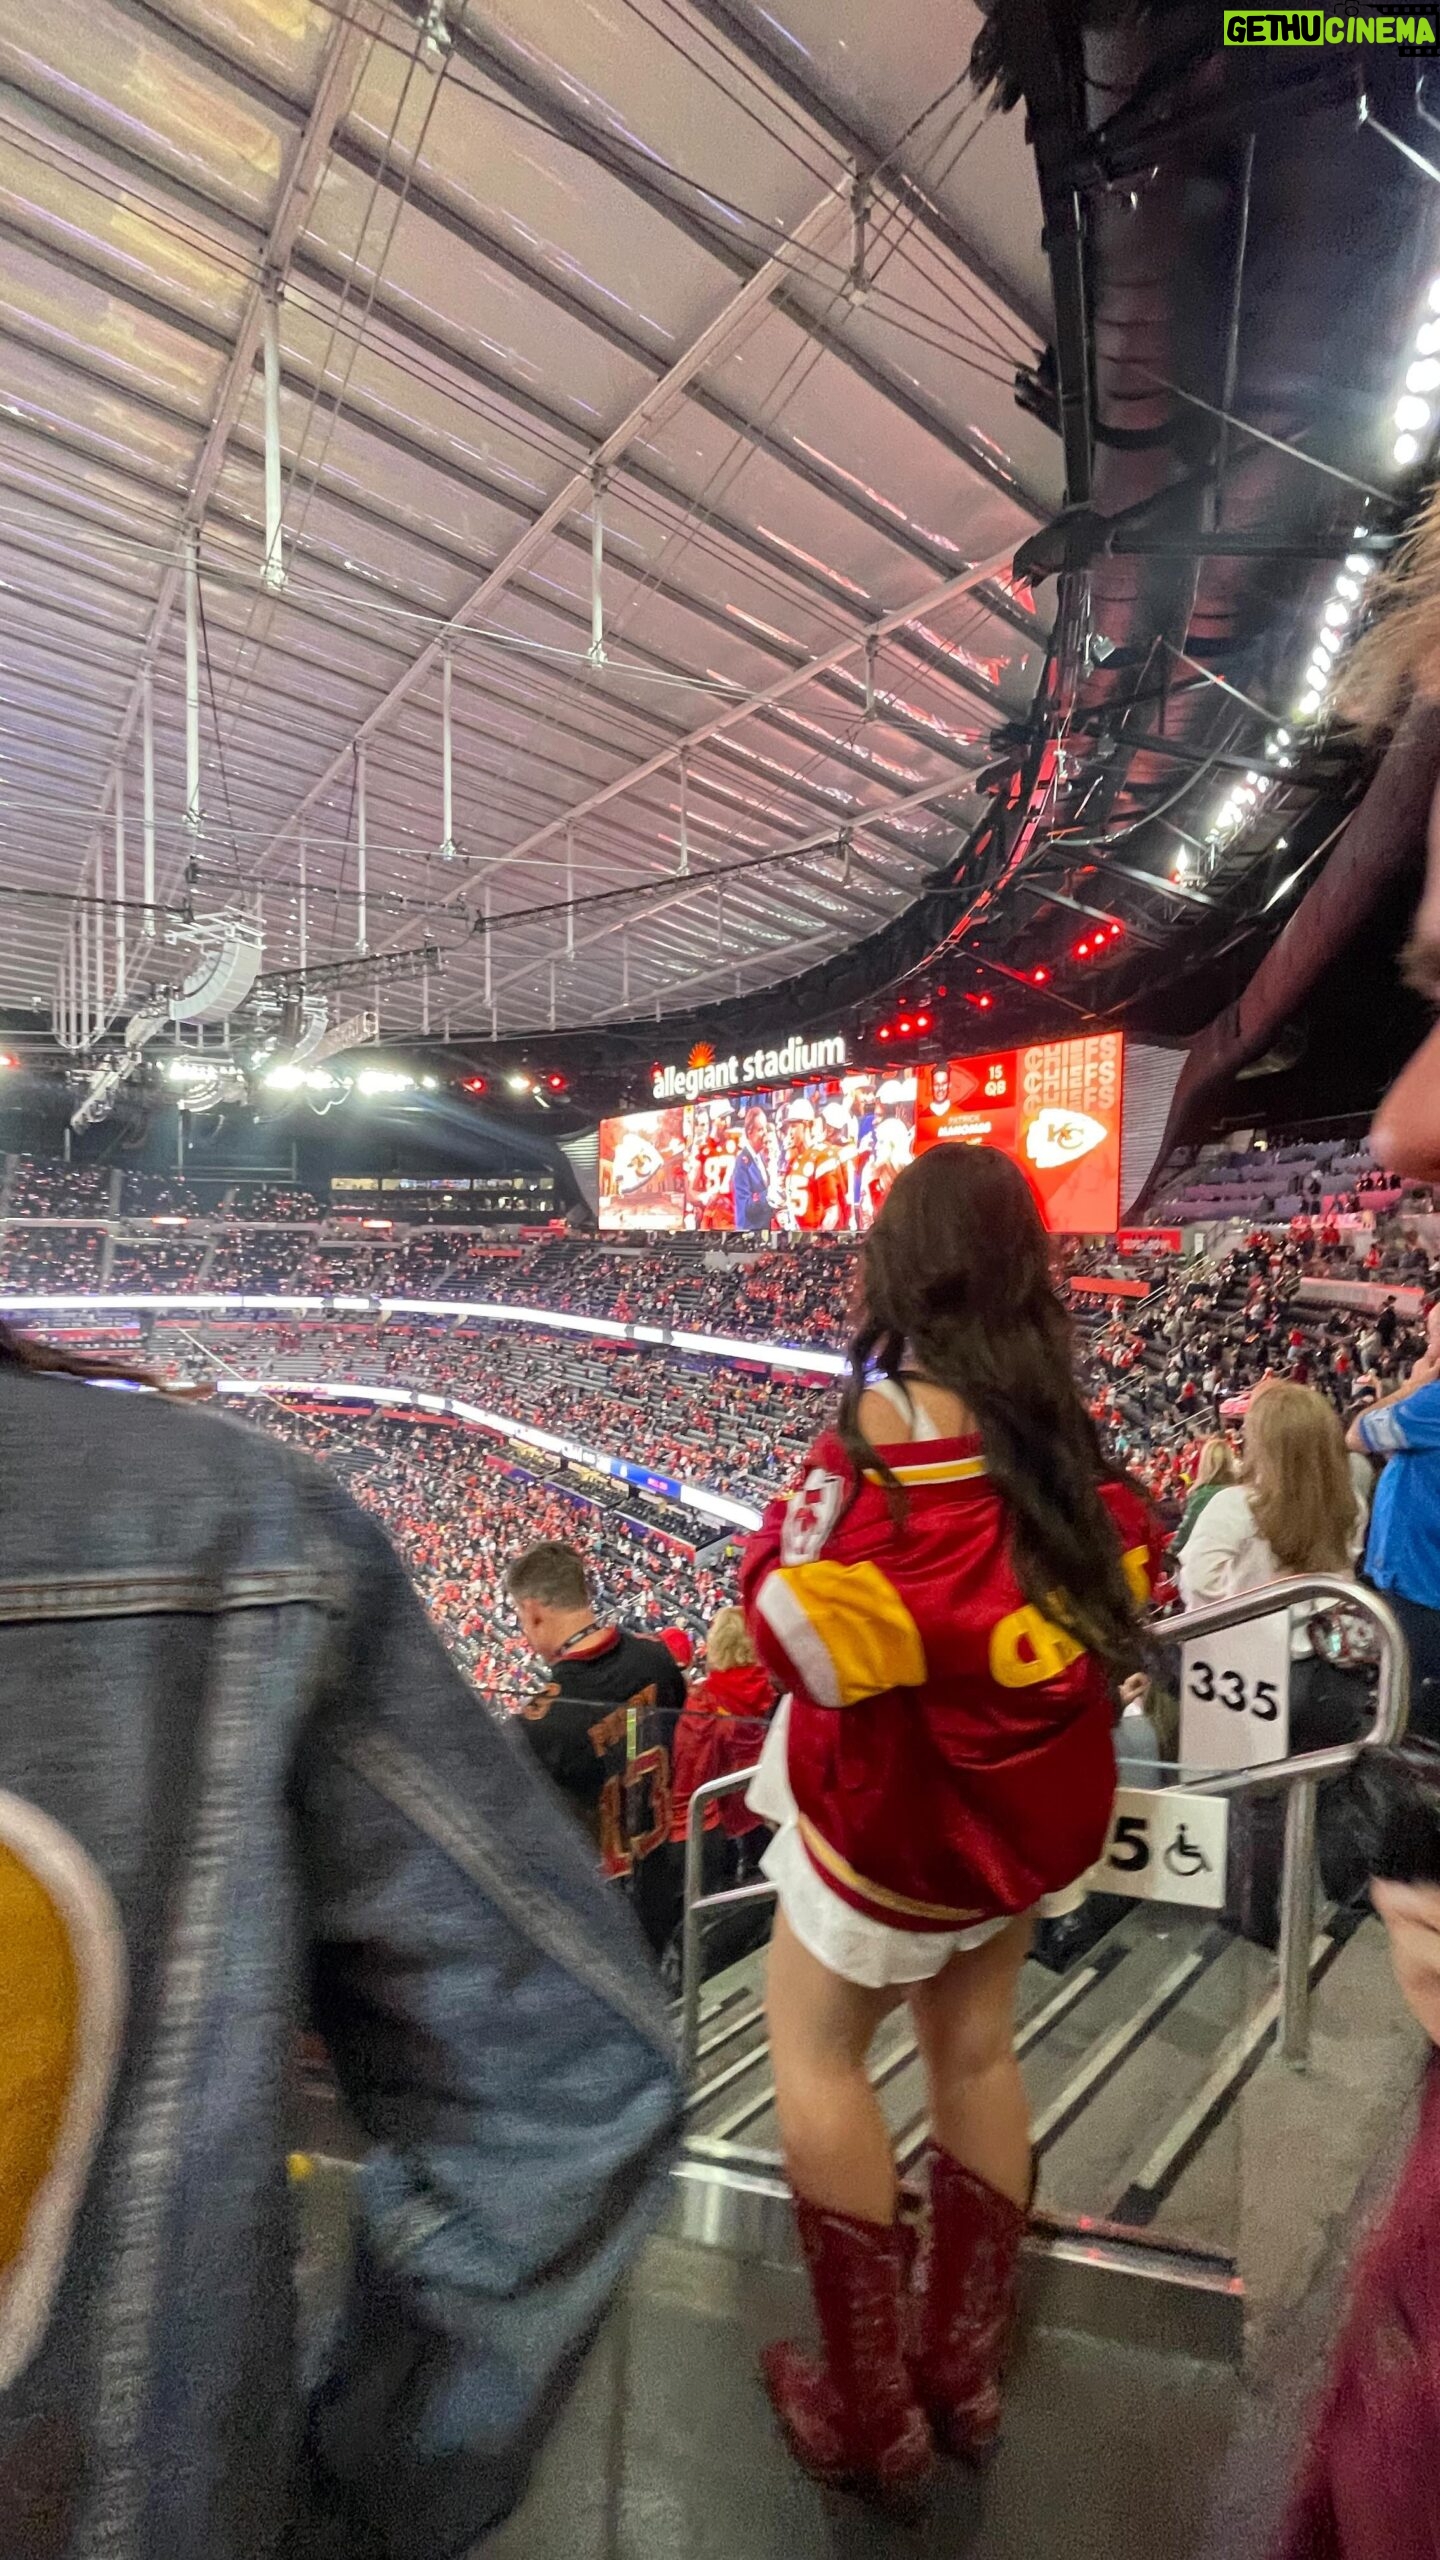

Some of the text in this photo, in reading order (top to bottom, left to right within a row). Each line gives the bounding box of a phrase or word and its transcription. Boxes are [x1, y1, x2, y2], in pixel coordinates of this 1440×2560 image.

[652, 1036, 846, 1101] allegiant stadium
[988, 1065, 1004, 1080] 15
[1023, 1034, 1117, 1073] CHIEFS
[984, 1080, 1007, 1097] QB
[1022, 1060, 1116, 1095] CHIEFS
[703, 1154, 736, 1195] 87
[1188, 1660, 1279, 1722] 335
